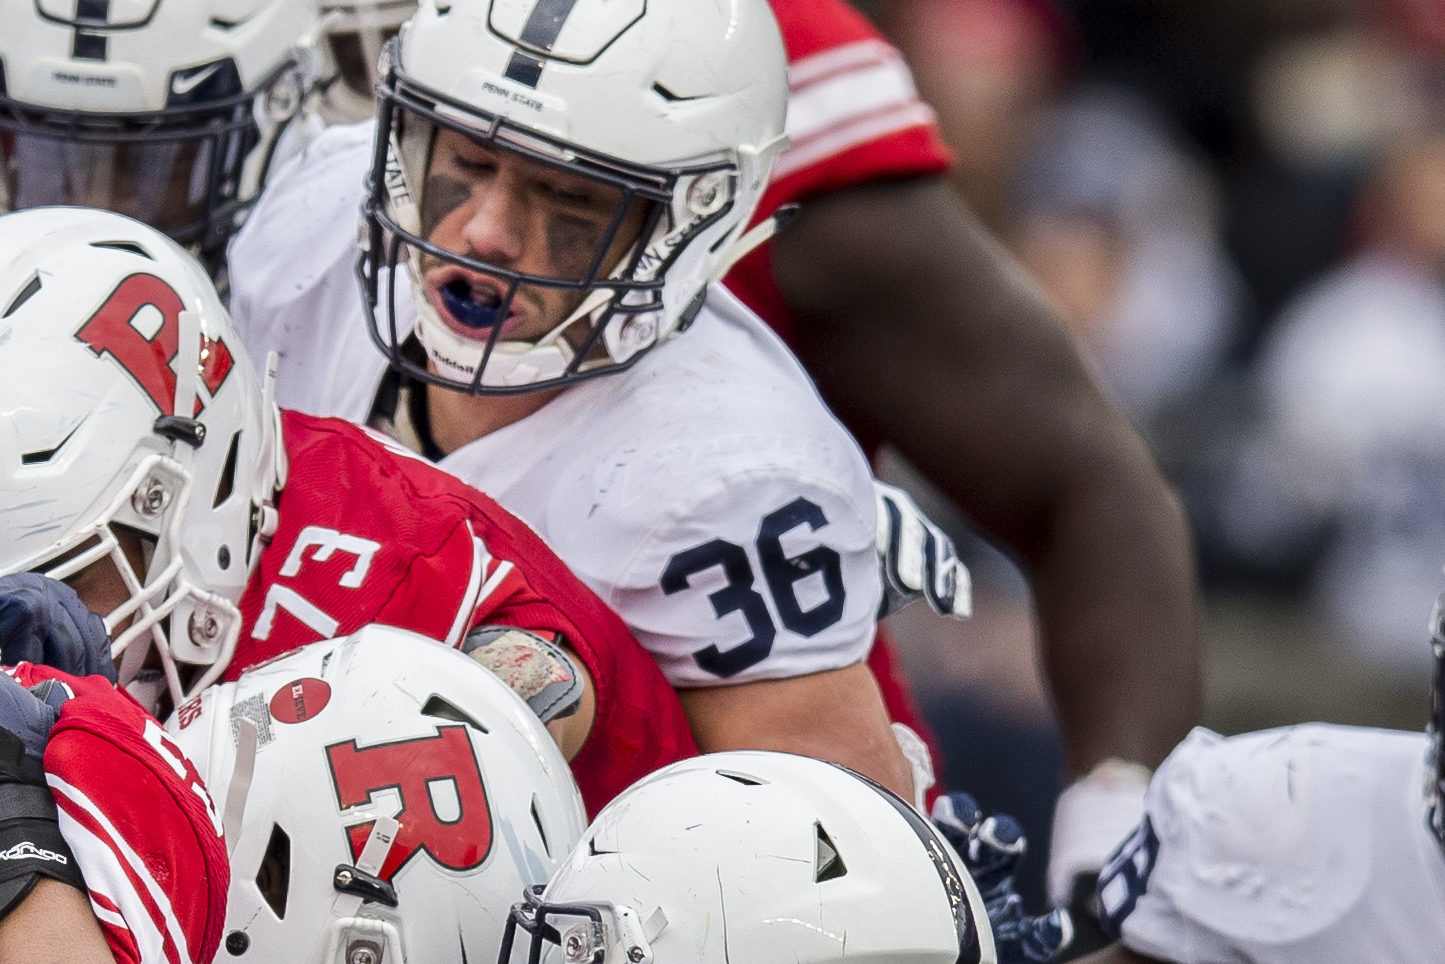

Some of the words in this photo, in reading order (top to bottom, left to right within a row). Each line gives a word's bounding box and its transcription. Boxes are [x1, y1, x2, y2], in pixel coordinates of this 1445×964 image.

[481, 81, 509, 98] PENN
[510, 92, 544, 112] STATE
[386, 140, 410, 208] TATE
[74, 272, 236, 420] R
[254, 524, 381, 641] 73
[659, 496, 847, 678] 36
[325, 723, 495, 886] R
